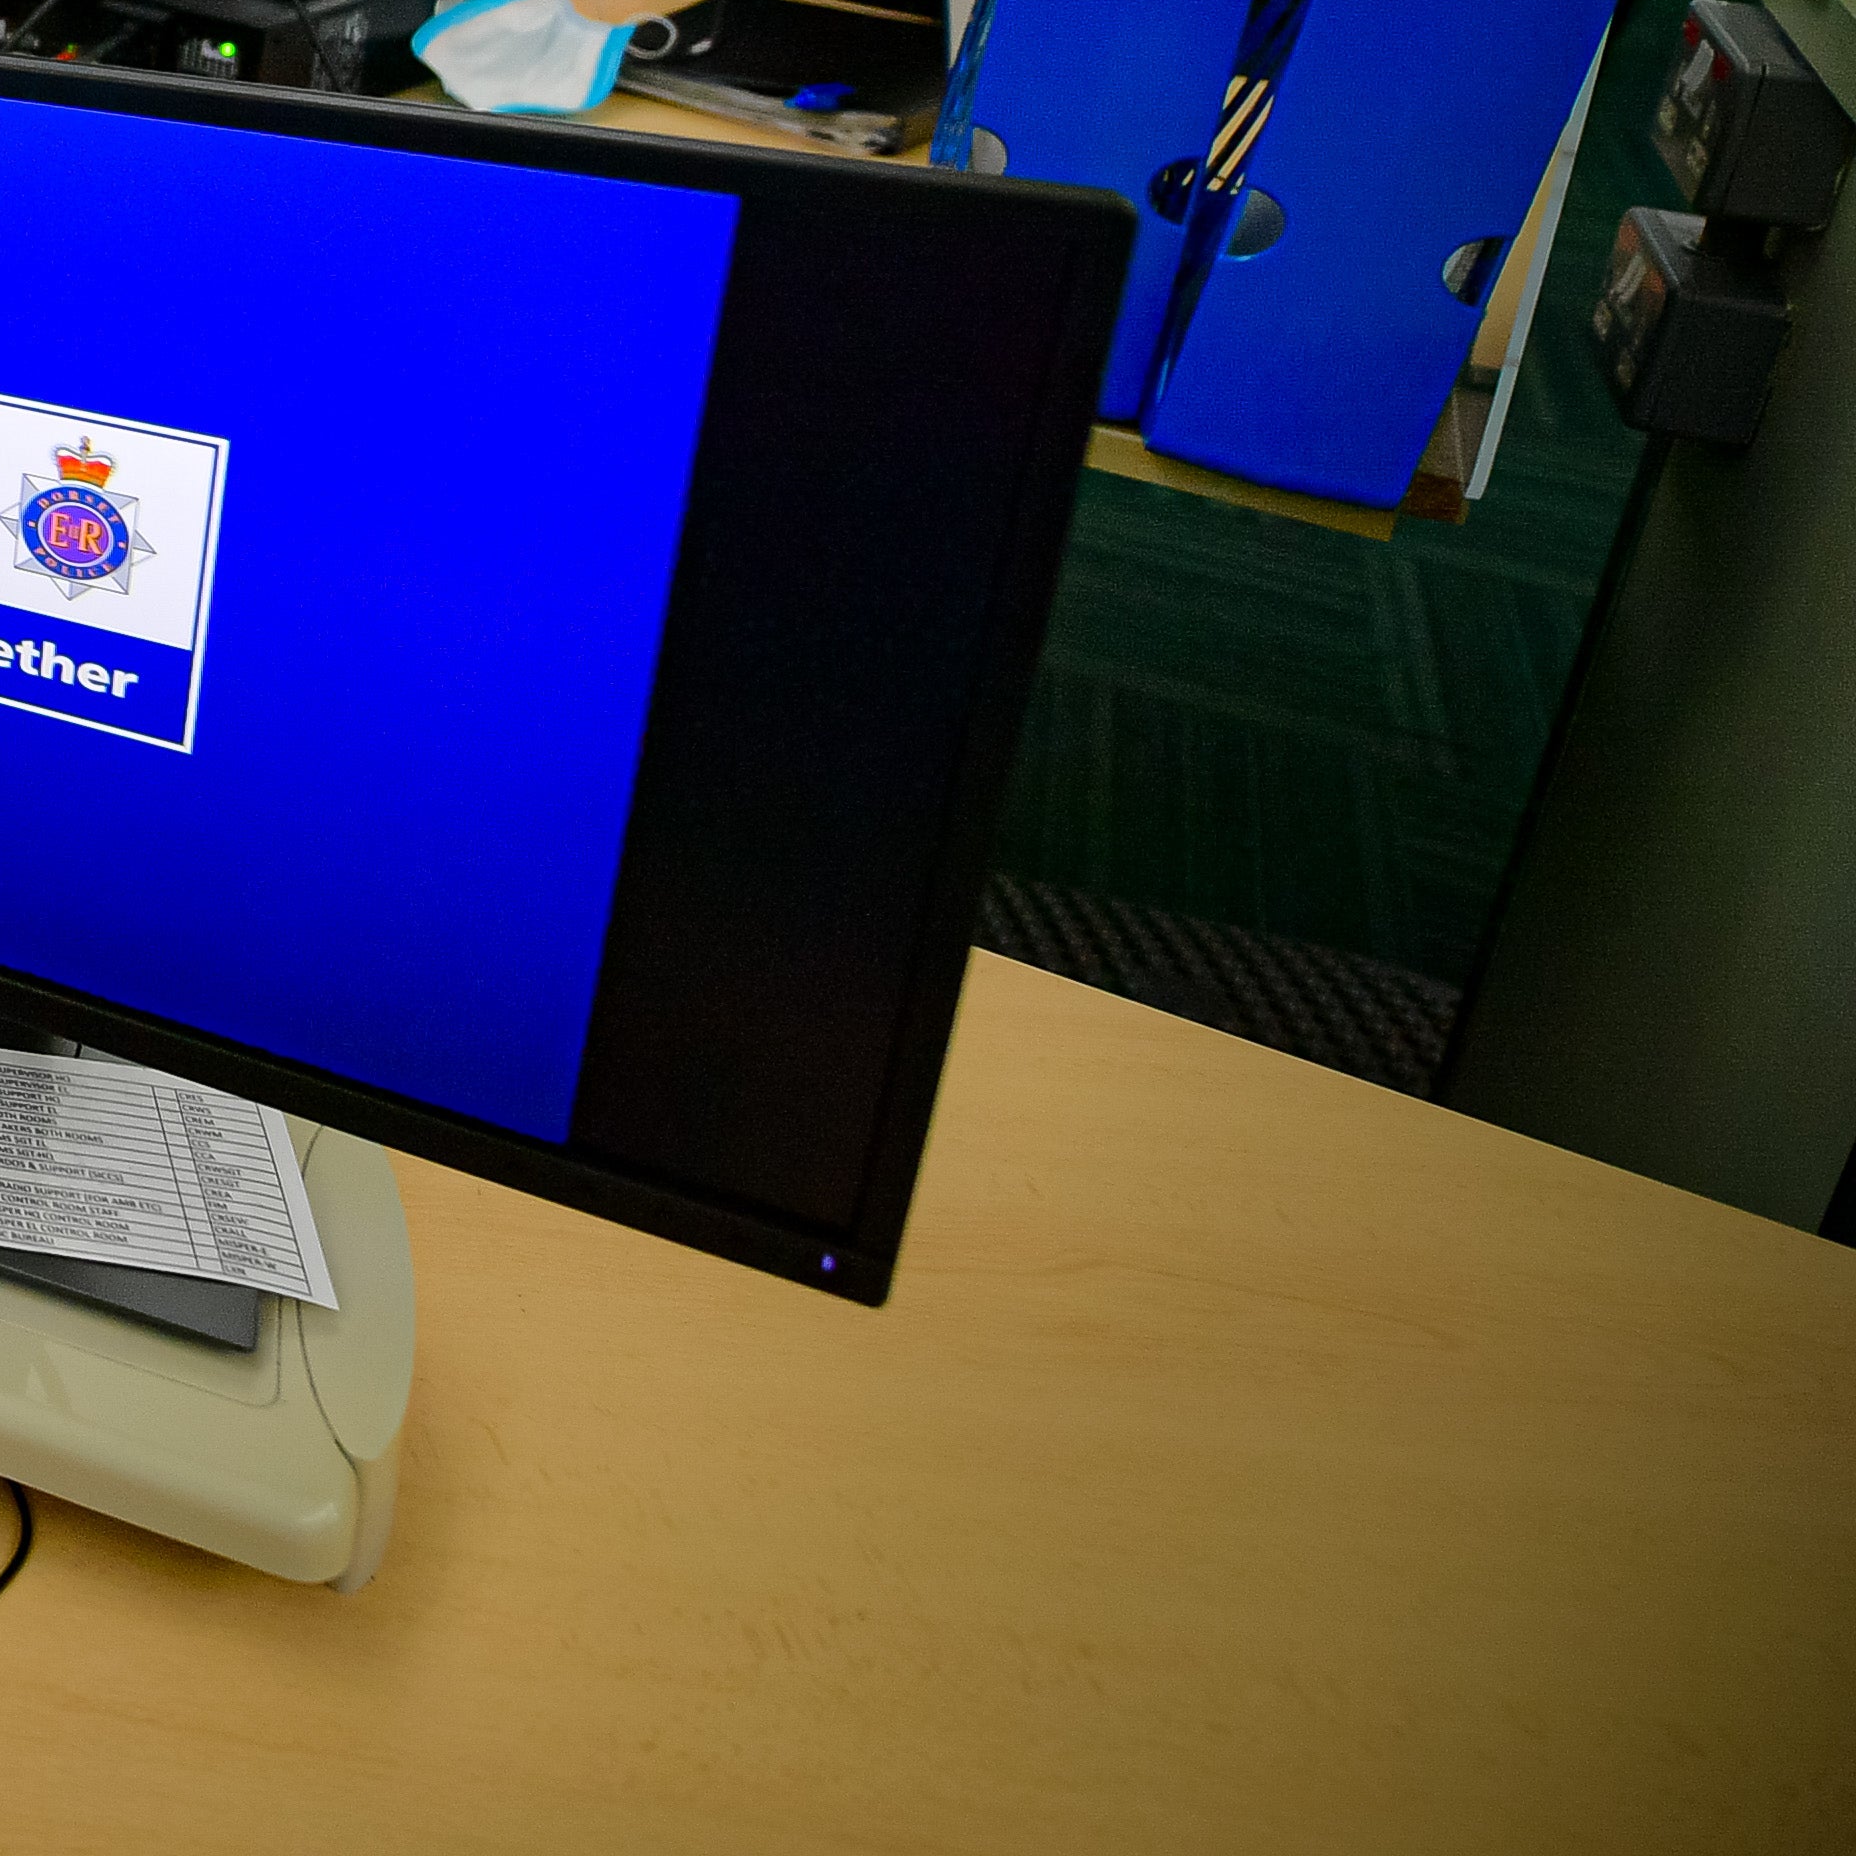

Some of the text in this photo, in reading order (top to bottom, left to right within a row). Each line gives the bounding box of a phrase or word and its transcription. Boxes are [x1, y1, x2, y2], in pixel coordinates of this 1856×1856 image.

[0, 1098, 45, 1113] SUPPORT
[17, 1113, 58, 1126] ROOMS
[34, 1126, 63, 1138] BOTH
[64, 1131, 104, 1144] ROOMS
[38, 1163, 86, 1177] SUPPORT
[33, 1185, 82, 1201] SUPPORT
[0, 1193, 50, 1208] CONTROL
[51, 1200, 87, 1213] ROOM
[42, 1211, 91, 1226] CONTROL
[93, 1218, 130, 1231] ROOM
[92, 1230, 128, 1243] ROOM
